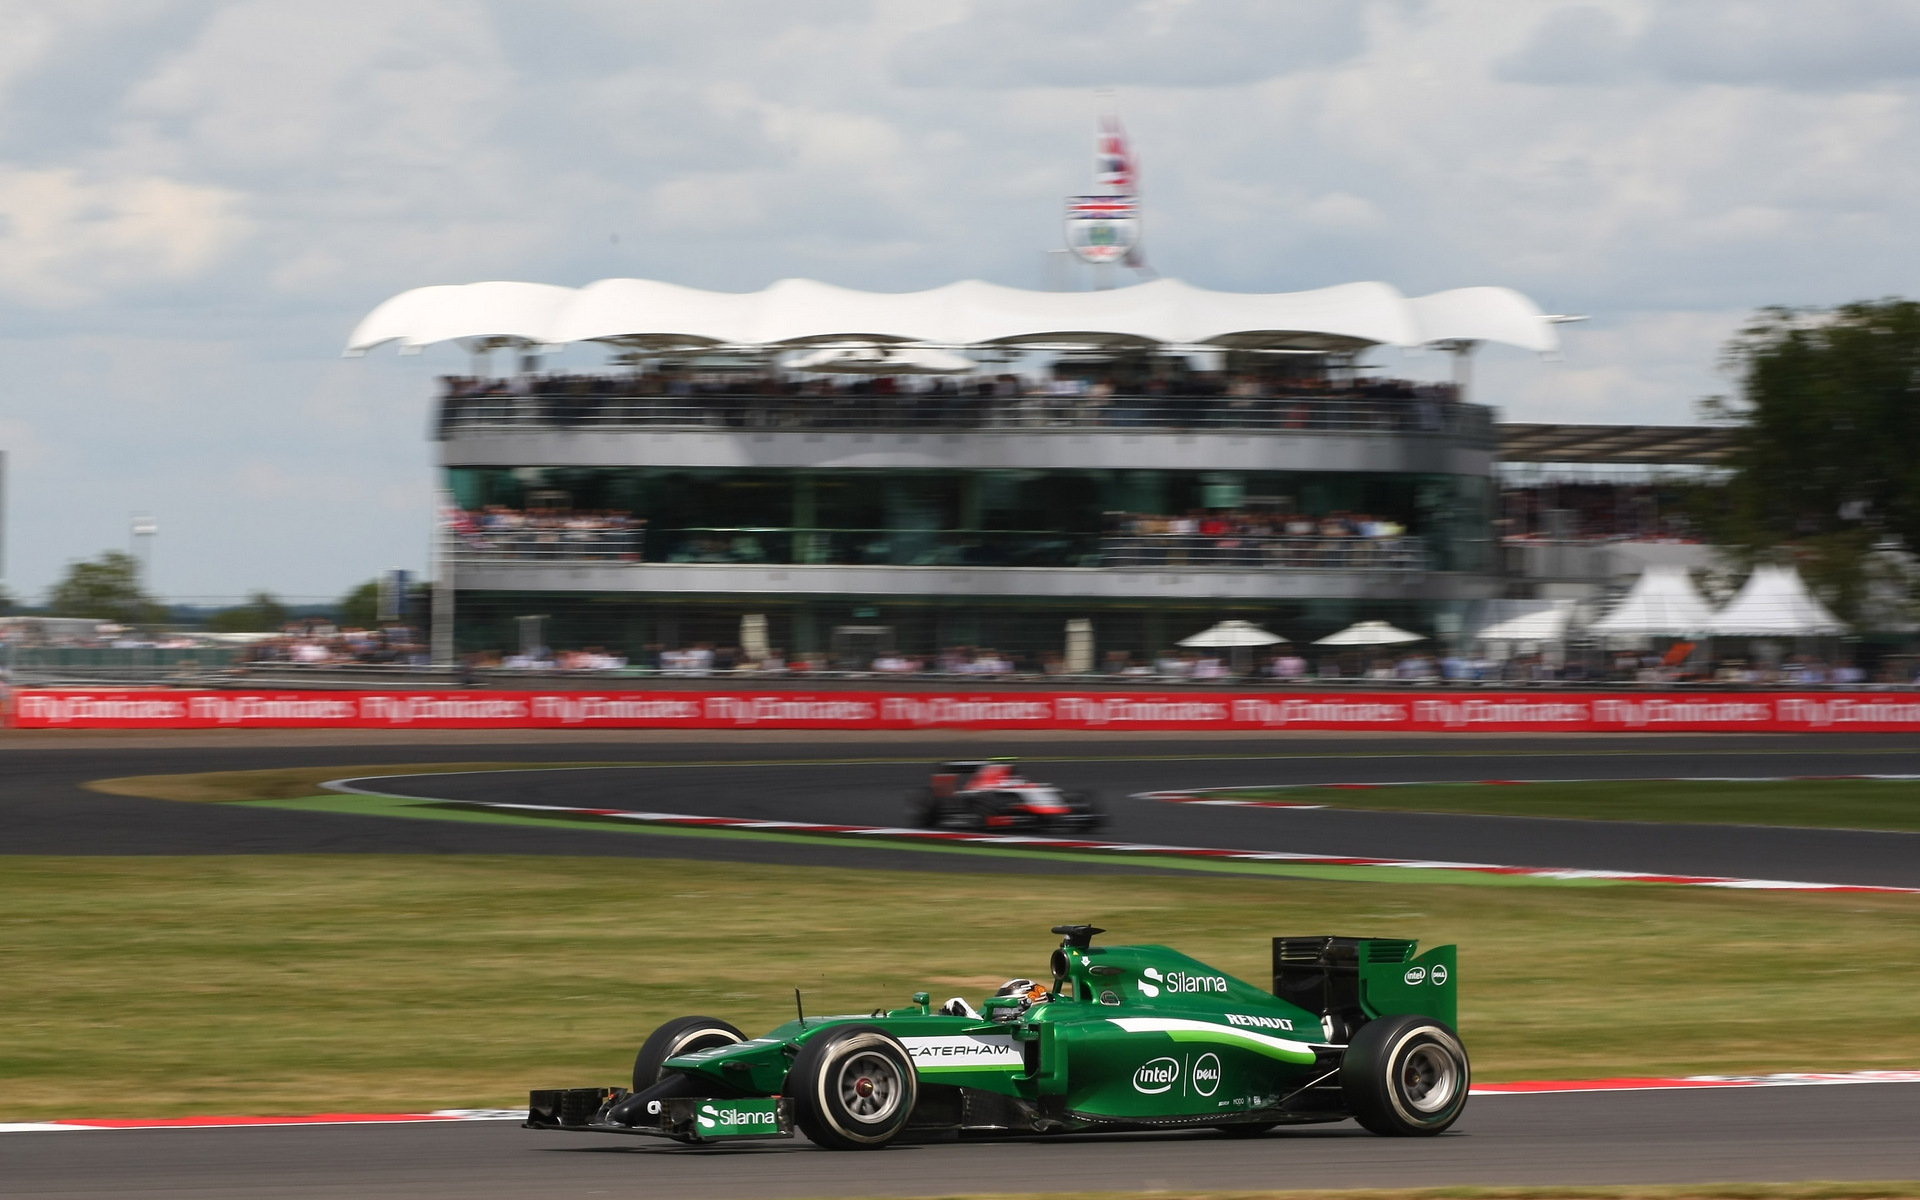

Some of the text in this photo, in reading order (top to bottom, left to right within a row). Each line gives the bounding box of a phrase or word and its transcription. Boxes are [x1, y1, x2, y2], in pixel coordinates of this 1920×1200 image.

[1166, 972, 1227, 993] Silanna
[1224, 1013, 1294, 1031] RENAULT
[908, 1045, 1010, 1057] CATERHAM
[1140, 1065, 1172, 1083] intel
[1196, 1069, 1218, 1080] DELL
[719, 1109, 775, 1125] Silanna
